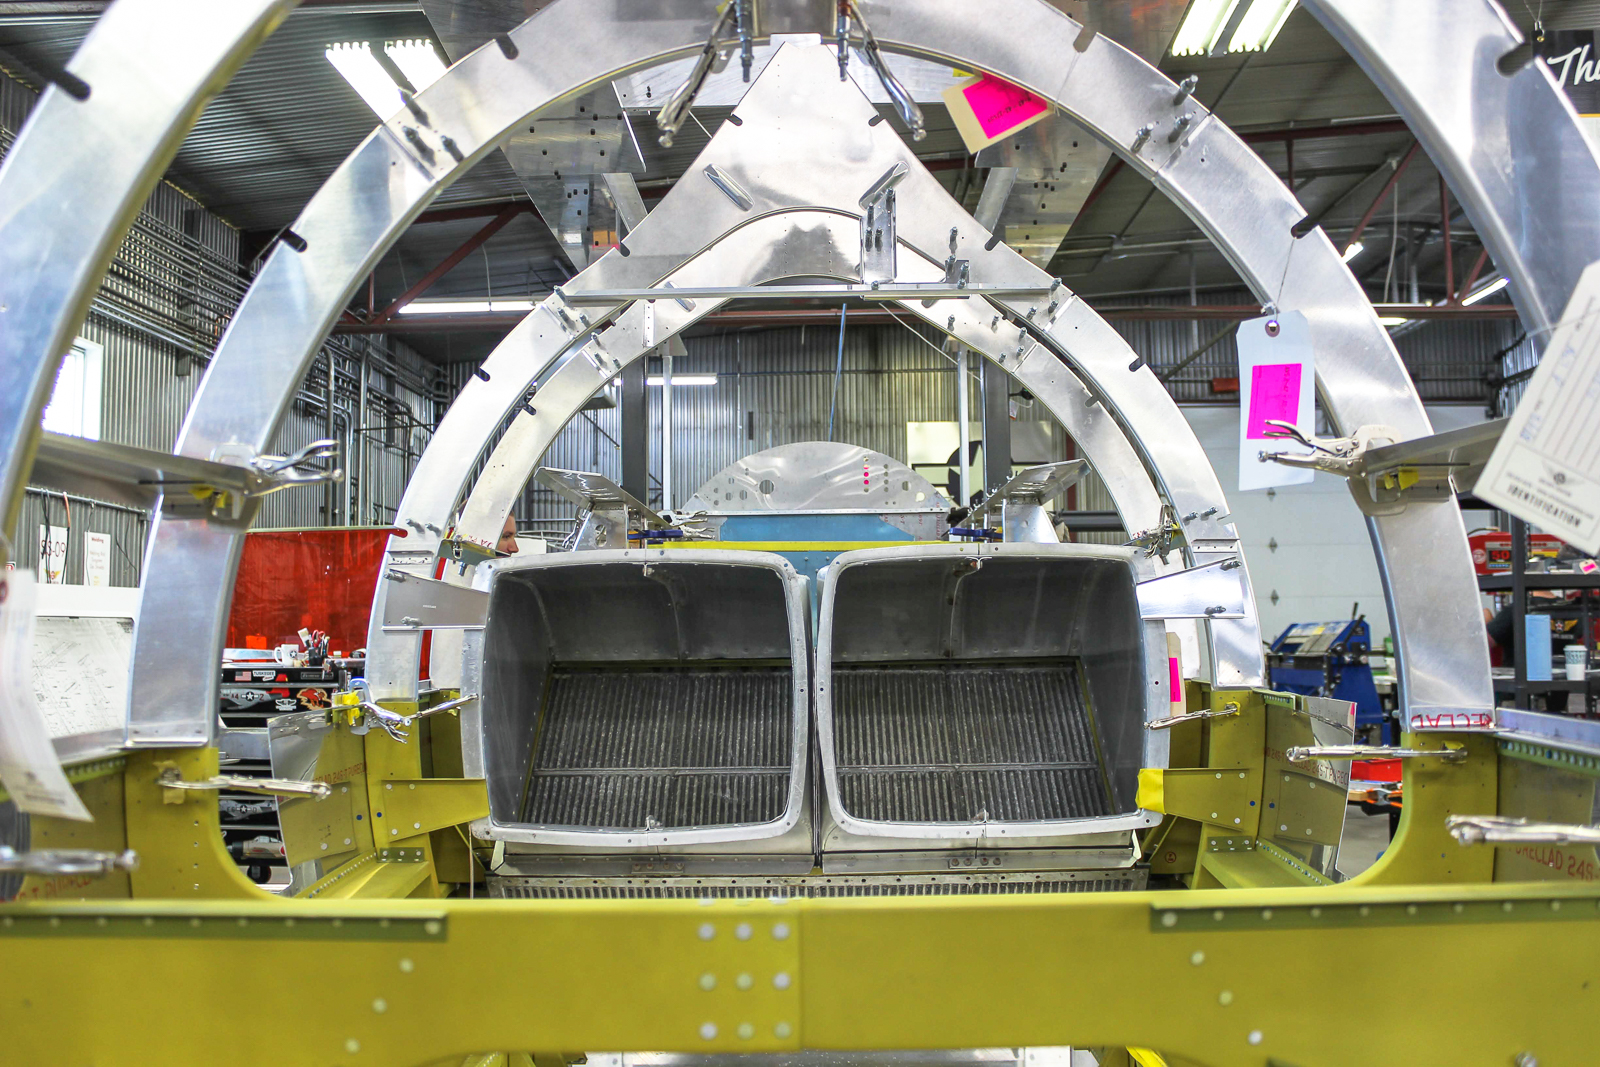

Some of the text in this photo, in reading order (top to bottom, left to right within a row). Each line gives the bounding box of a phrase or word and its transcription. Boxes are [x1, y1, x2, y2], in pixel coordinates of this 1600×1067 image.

[1507, 484, 1582, 528] IDENTIFICATION
[1491, 549, 1511, 560] 50
[1567, 855, 1600, 882] 24S-
